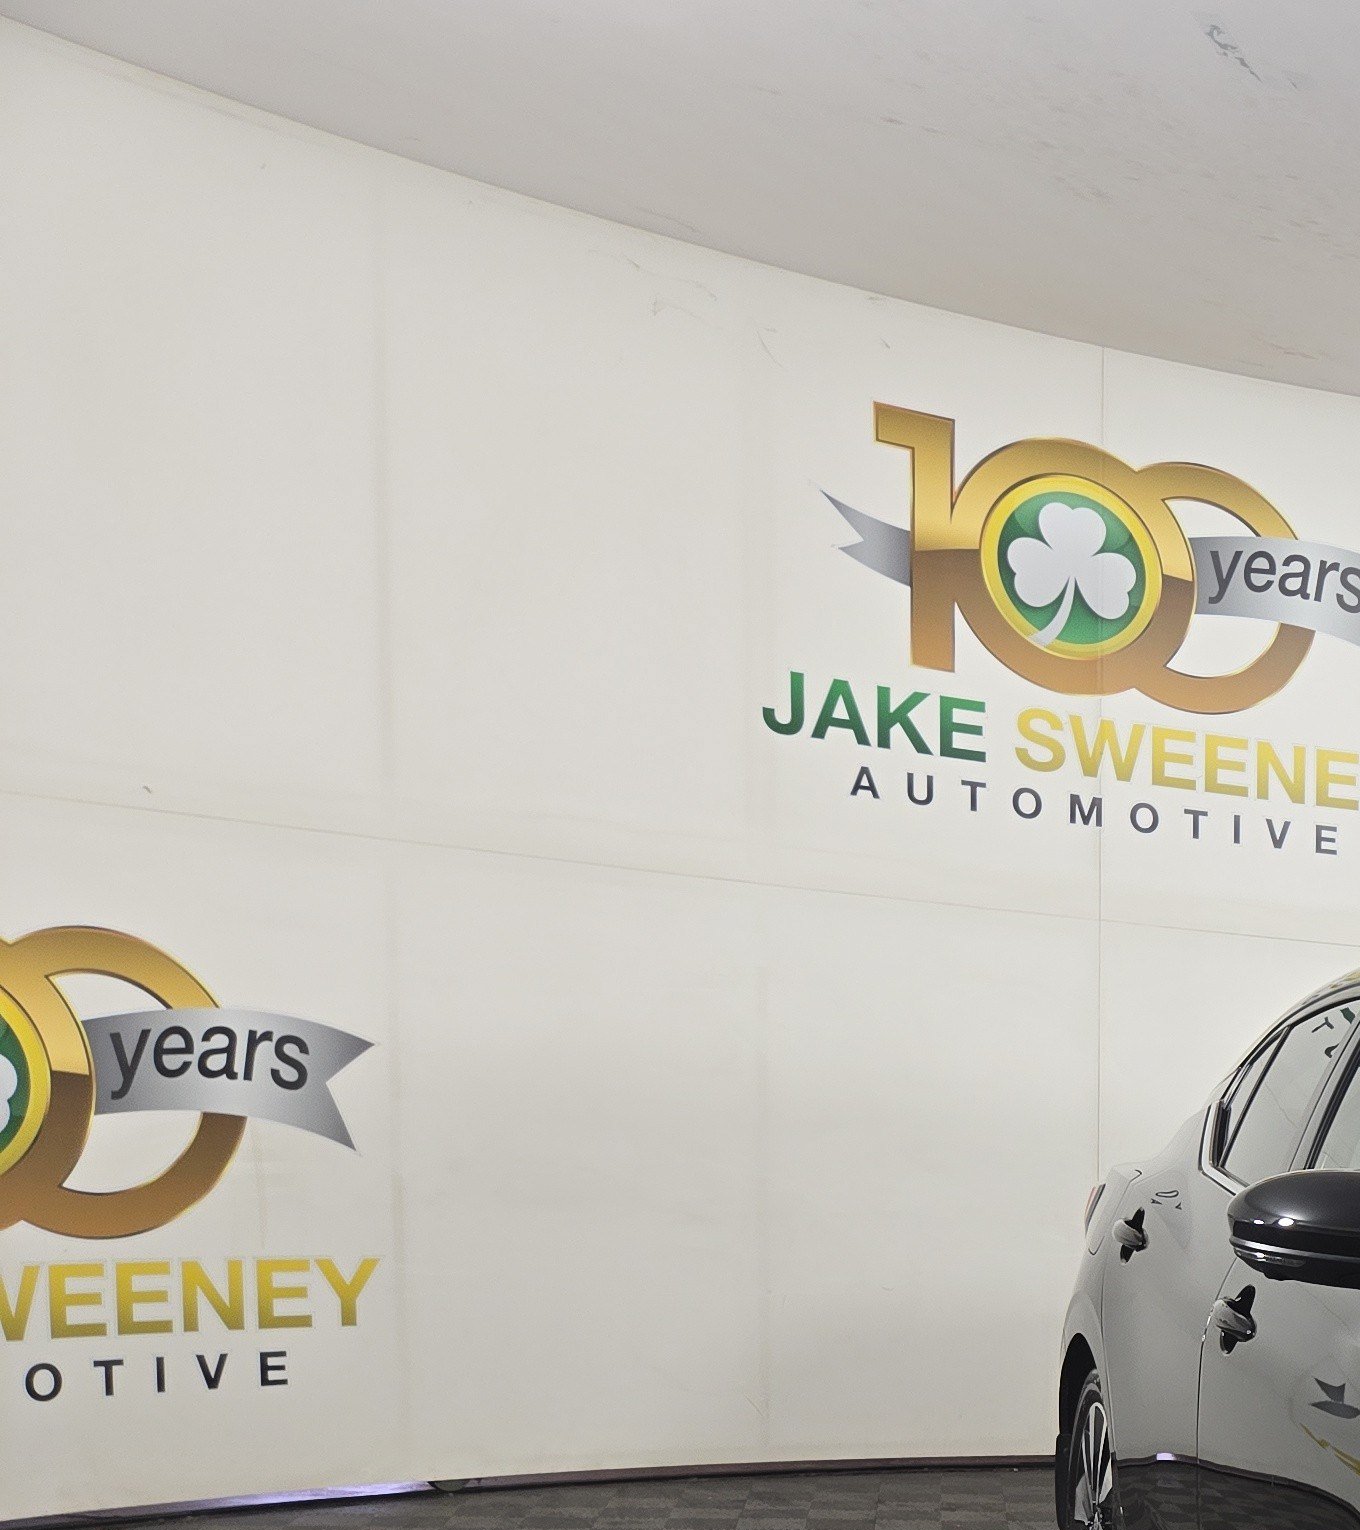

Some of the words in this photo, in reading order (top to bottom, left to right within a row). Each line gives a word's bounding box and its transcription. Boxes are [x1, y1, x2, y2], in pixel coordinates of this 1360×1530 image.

[872, 400, 1315, 714] 100
[762, 671, 987, 763] JAKE
[850, 766, 1339, 856] AUTOMOTIVE
[109, 1024, 310, 1100] years
